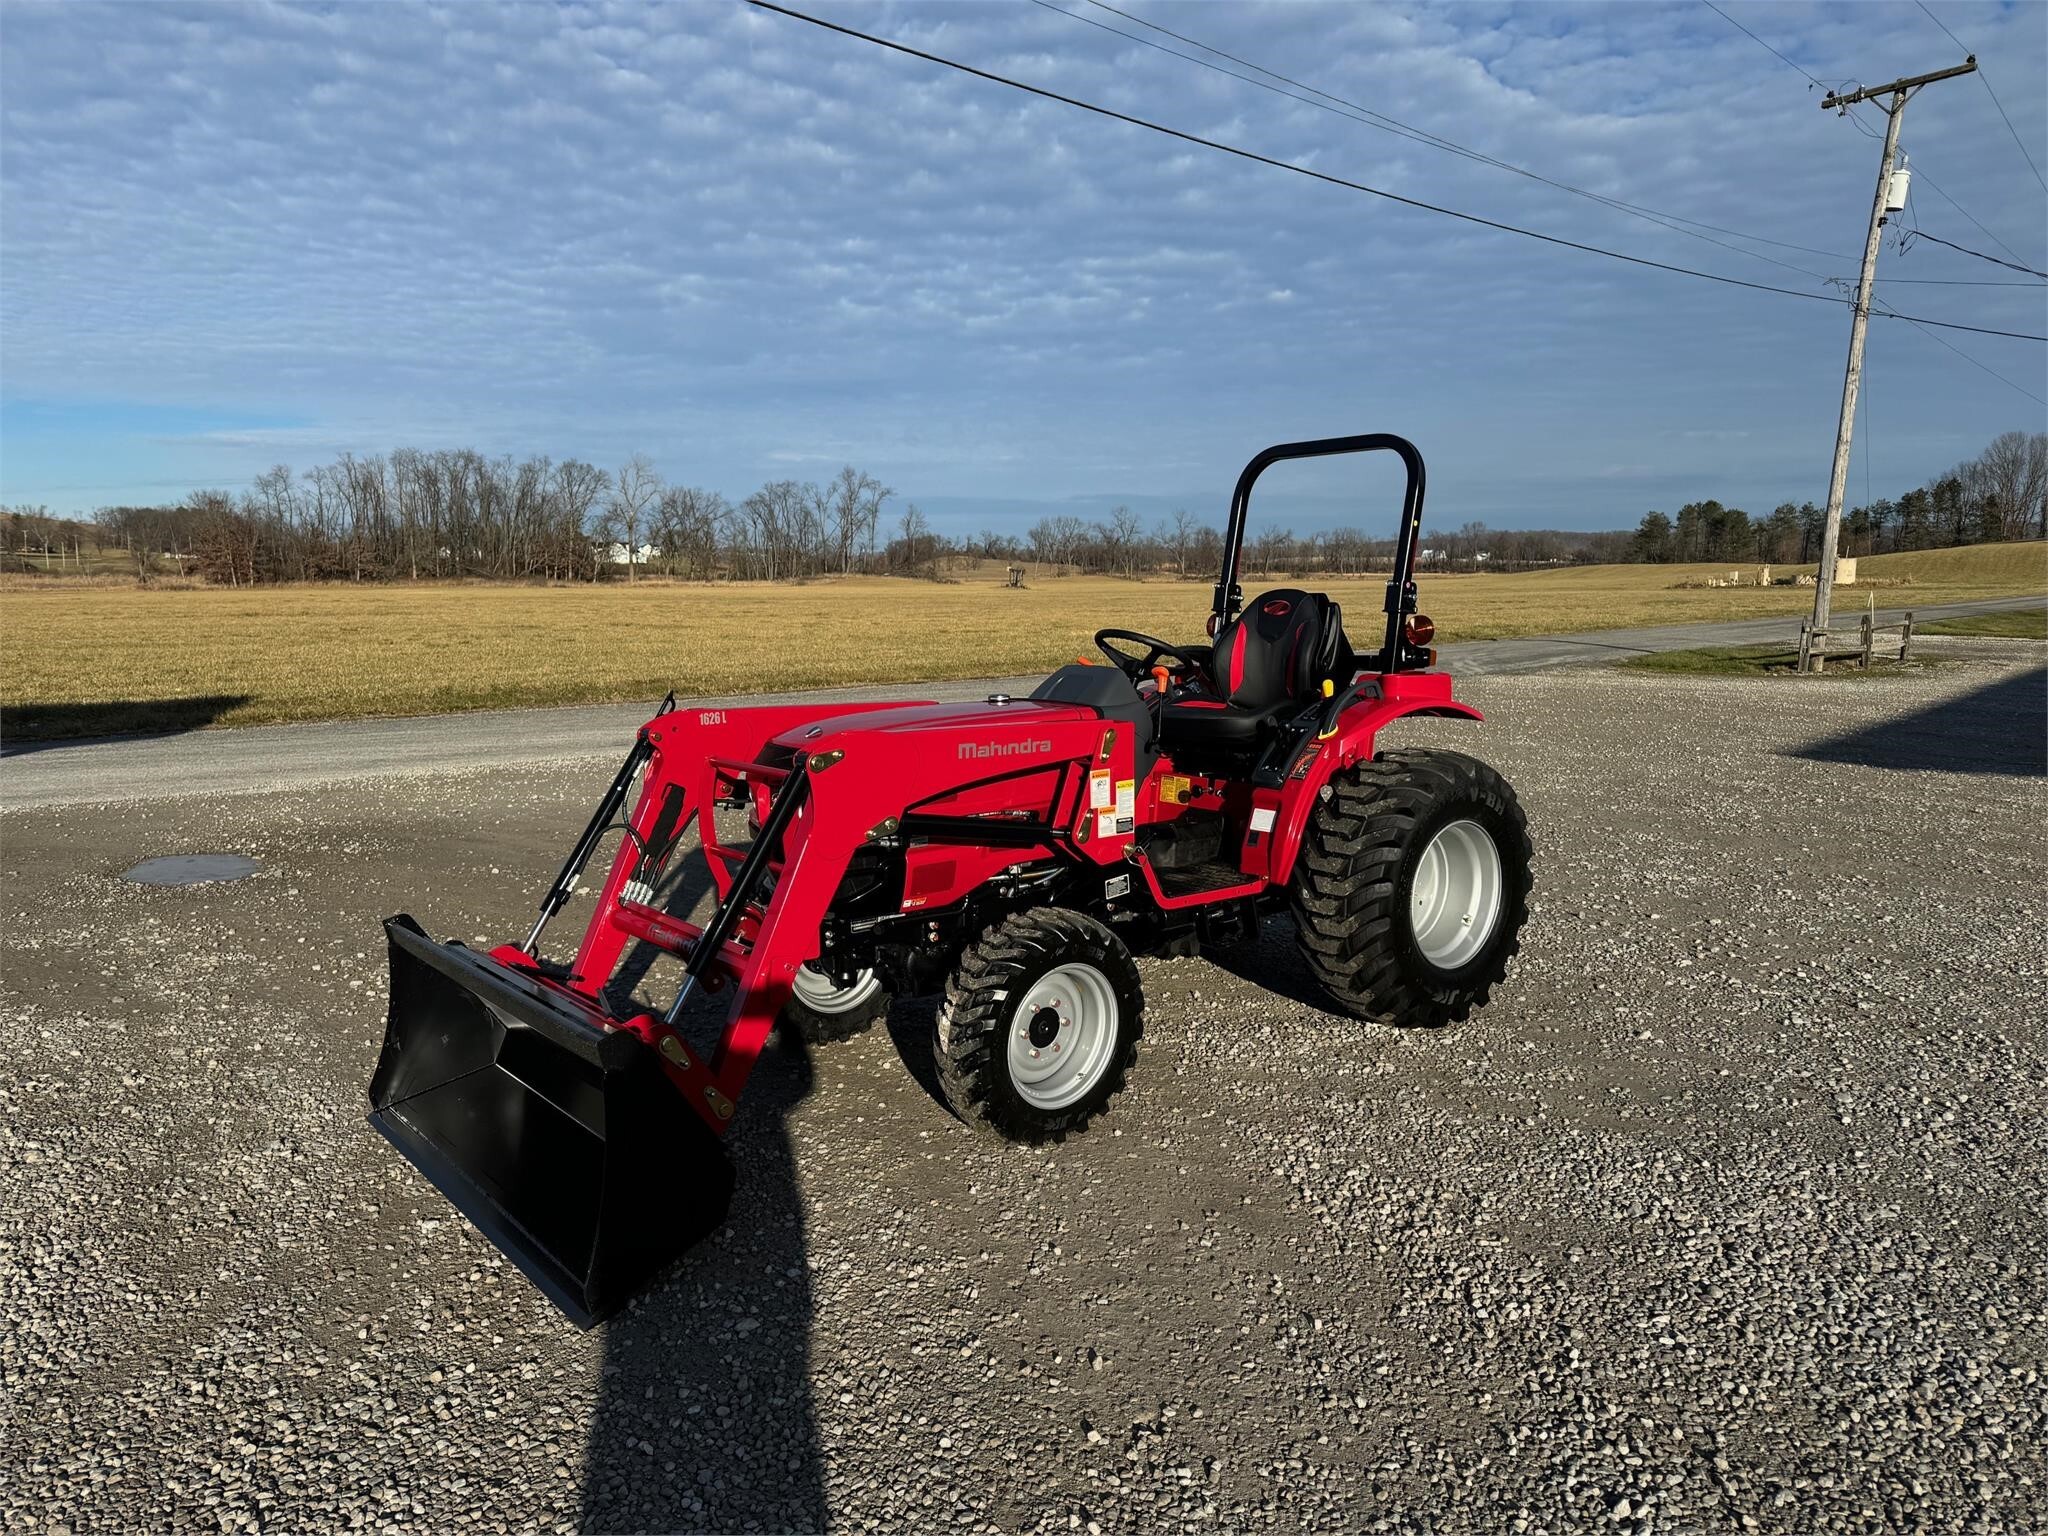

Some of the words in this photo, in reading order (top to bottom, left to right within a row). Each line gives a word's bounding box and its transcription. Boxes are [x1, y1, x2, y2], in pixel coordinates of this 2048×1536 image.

[699, 711, 721, 726] 1626
[721, 711, 727, 724] L
[958, 738, 1052, 760] Mahindra
